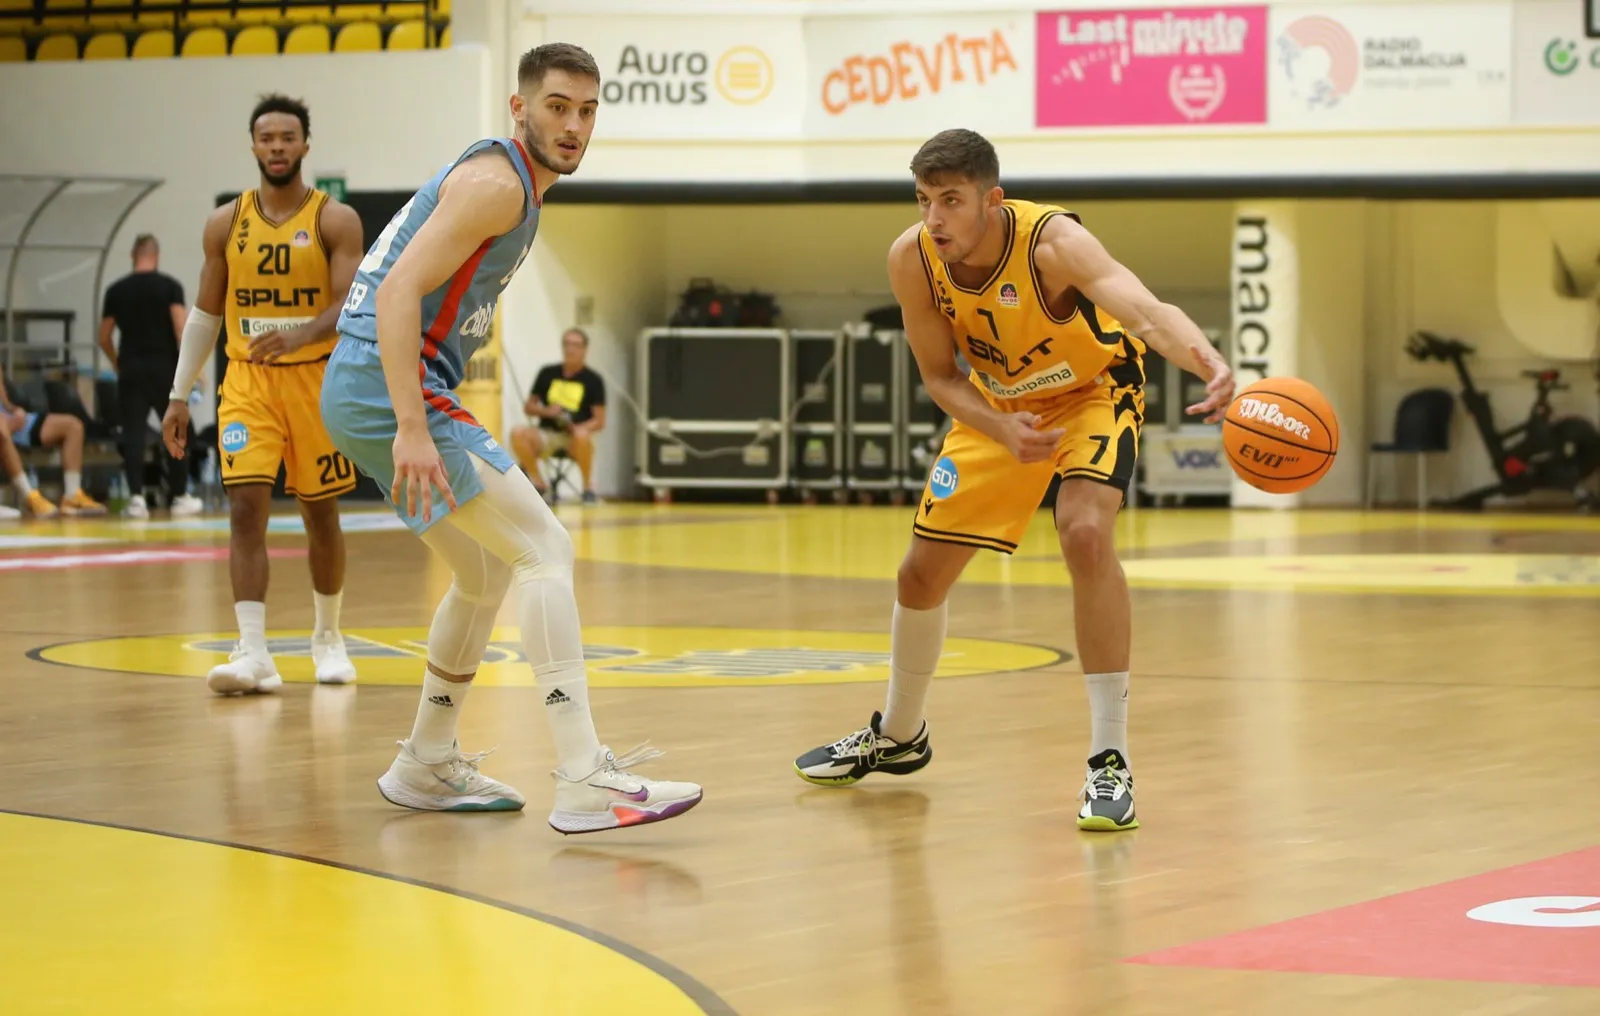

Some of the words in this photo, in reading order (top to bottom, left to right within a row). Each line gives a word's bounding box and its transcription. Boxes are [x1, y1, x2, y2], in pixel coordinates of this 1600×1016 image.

[1058, 14, 1127, 45] Last
[1133, 12, 1248, 44] minute
[1363, 38, 1421, 51] RADIO
[617, 44, 709, 75] Auro
[821, 28, 1018, 116] CEDEVITA
[1364, 53, 1467, 69] DALMACIJA
[602, 80, 708, 105] omus
[258, 244, 291, 276] 20
[235, 288, 320, 308] SPLIT
[1239, 216, 1270, 379] macr
[977, 307, 1000, 341] 7
[966, 334, 1054, 377] SPLIT
[991, 368, 1073, 397] Groupama
[1239, 398, 1311, 441] Wilson
[221, 427, 248, 447] GDi
[1088, 435, 1111, 465] 7
[316, 450, 351, 485] 20
[1172, 449, 1221, 470] VOX
[1239, 443, 1284, 469] EVO
[932, 466, 957, 490] GDi
[545, 696, 571, 706] adidas
